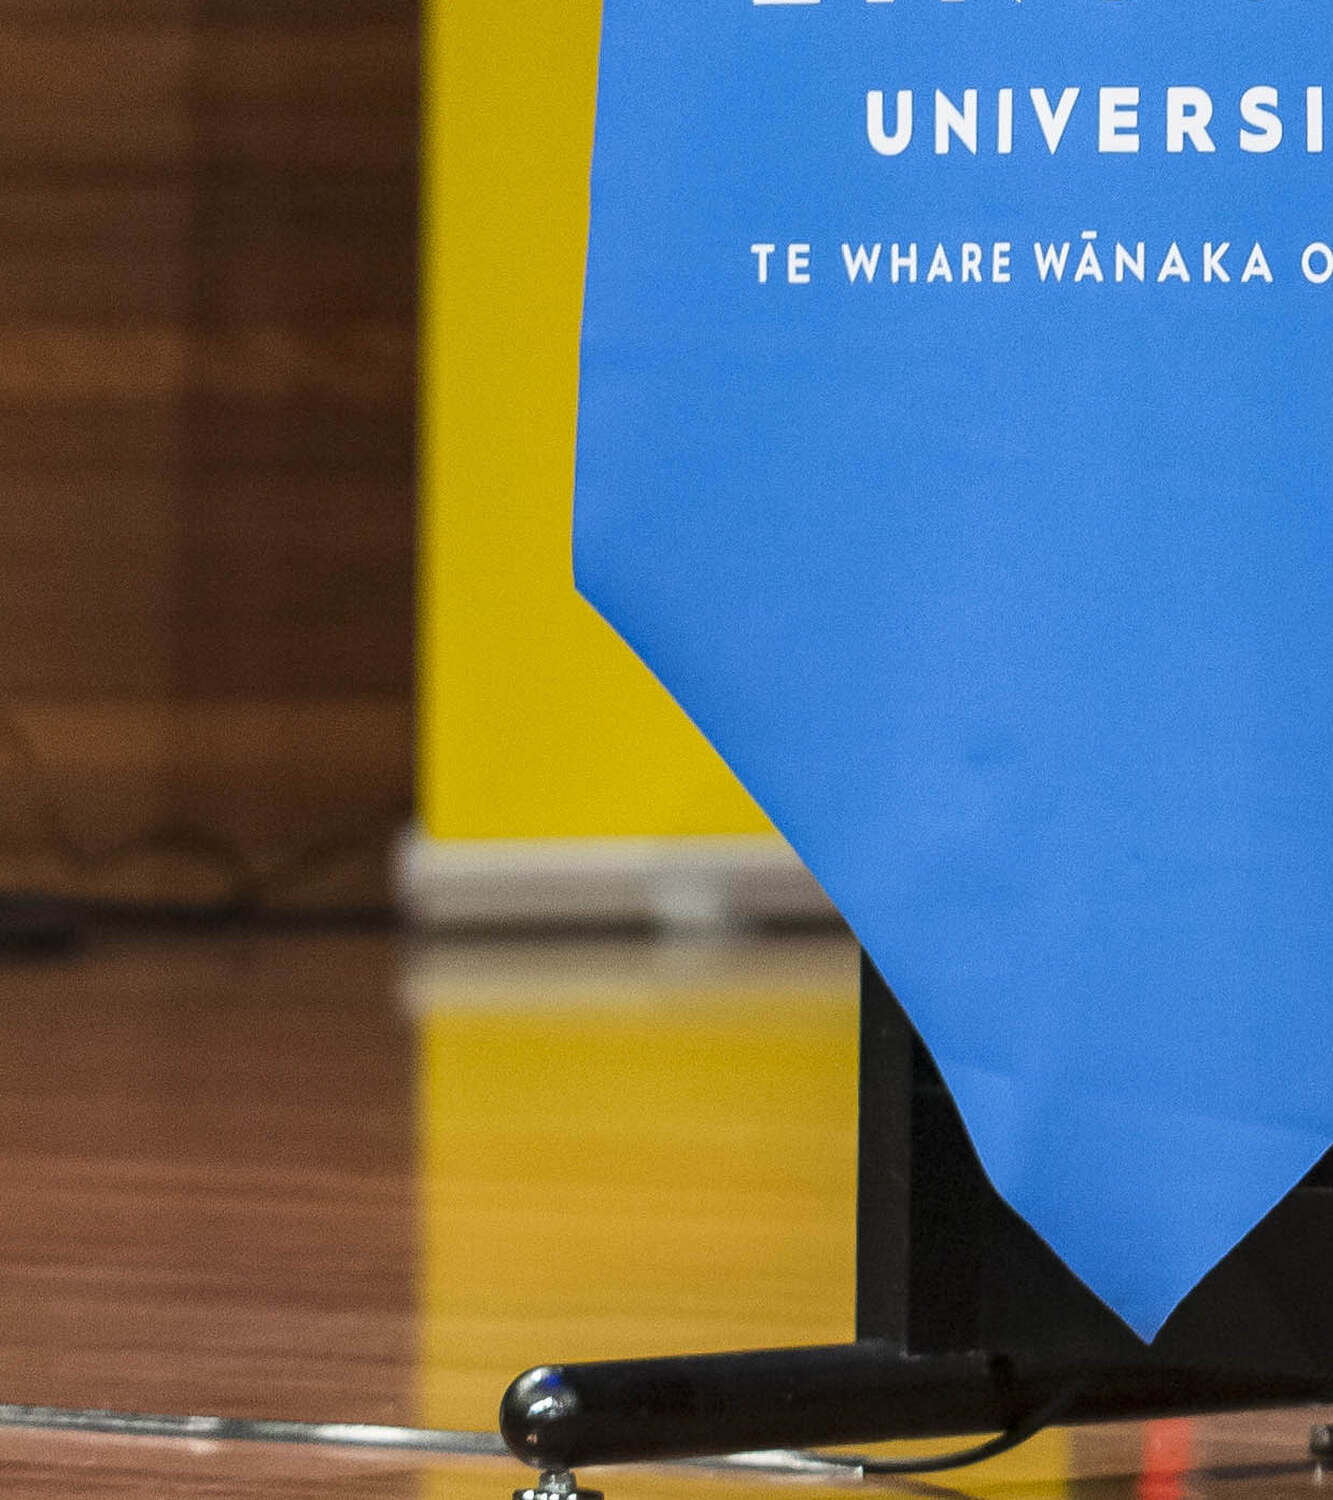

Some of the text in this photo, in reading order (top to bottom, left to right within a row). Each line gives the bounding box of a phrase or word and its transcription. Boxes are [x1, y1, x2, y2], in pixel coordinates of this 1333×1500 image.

[750, 242, 811, 285] TE
[840, 242, 1012, 285] WHARE
[1033, 229, 1274, 285] WĀNAKA
